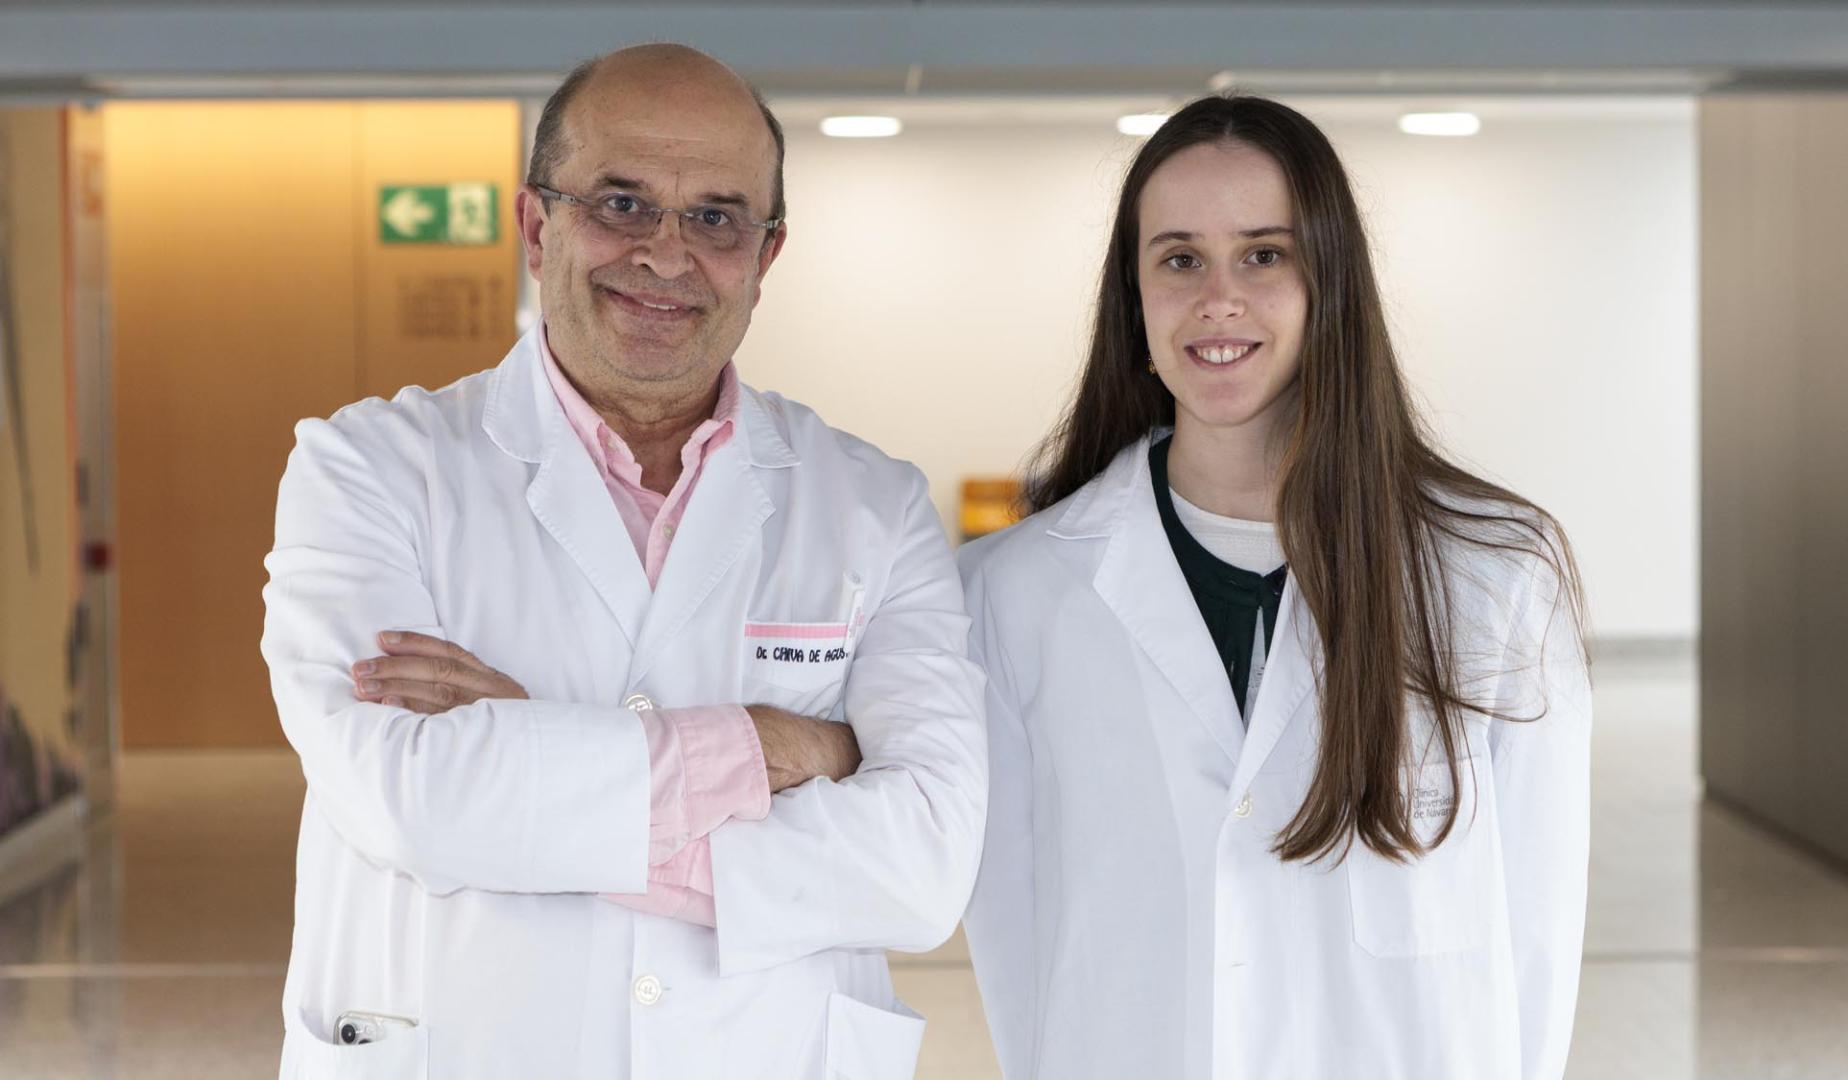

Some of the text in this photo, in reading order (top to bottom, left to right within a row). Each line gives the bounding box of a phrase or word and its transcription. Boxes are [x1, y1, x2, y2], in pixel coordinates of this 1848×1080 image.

[773, 647, 804, 662] CHIVA
[809, 649, 821, 662] DE
[824, 647, 848, 662] AGUS
[1414, 810, 1424, 819] de
